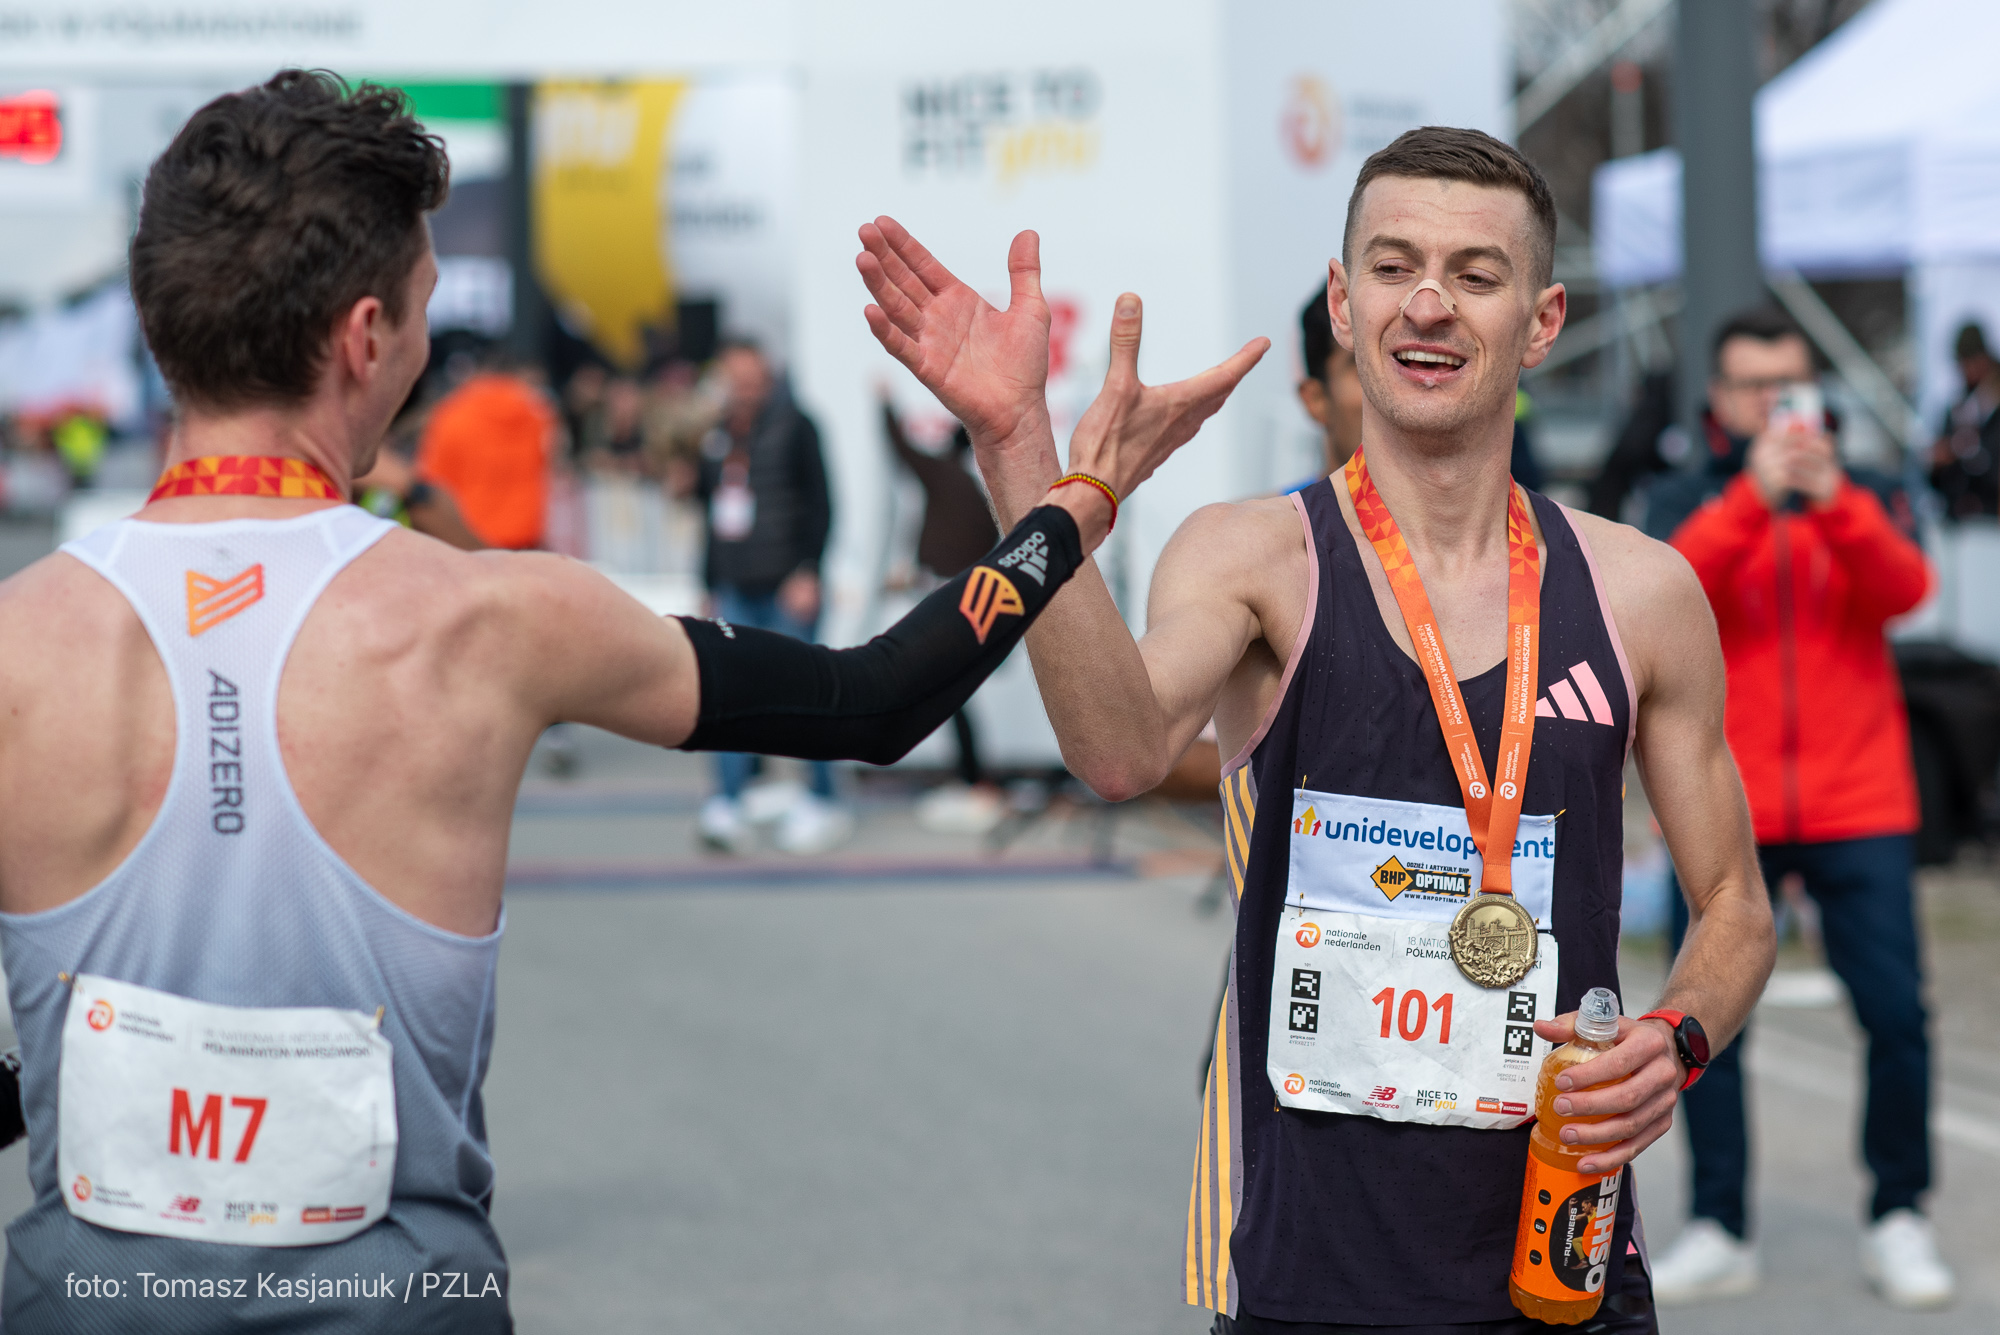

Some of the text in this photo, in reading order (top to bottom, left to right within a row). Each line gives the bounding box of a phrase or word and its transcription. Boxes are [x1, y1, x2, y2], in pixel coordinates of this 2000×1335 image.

[998, 531, 1046, 568] adidas
[1424, 623, 1446, 674] WARSZAWSKI
[1521, 625, 1531, 673] WARSZAWSKI
[208, 669, 245, 835] ADIZERO
[1463, 742, 1478, 780] nederlanden
[1505, 751, 1513, 780] nationale
[1510, 742, 1520, 780] nederlanden
[1460, 753, 1473, 780] nationale
[1325, 817, 1555, 860] unidevelopent
[1380, 870, 1406, 885] BHP
[1415, 872, 1466, 893] OPTIMA
[1404, 893, 1468, 904] WWW.BHPOPTIMA.PL
[1324, 938, 1381, 952] nederlanden
[1325, 928, 1368, 941] nationale
[1407, 936, 1417, 945] 18.
[1405, 947, 1454, 961] PÓŁMARA
[1372, 986, 1454, 1045] 101
[1307, 1086, 1352, 1099] nederlanden
[1308, 1078, 1342, 1090] nationale
[1417, 1089, 1458, 1101] NICE TO
[1361, 1099, 1400, 1109] new balance
[167, 1086, 269, 1164] M7
[1564, 1207, 1578, 1257] RUNNERS
[1585, 1171, 1621, 1293] OSHEE
